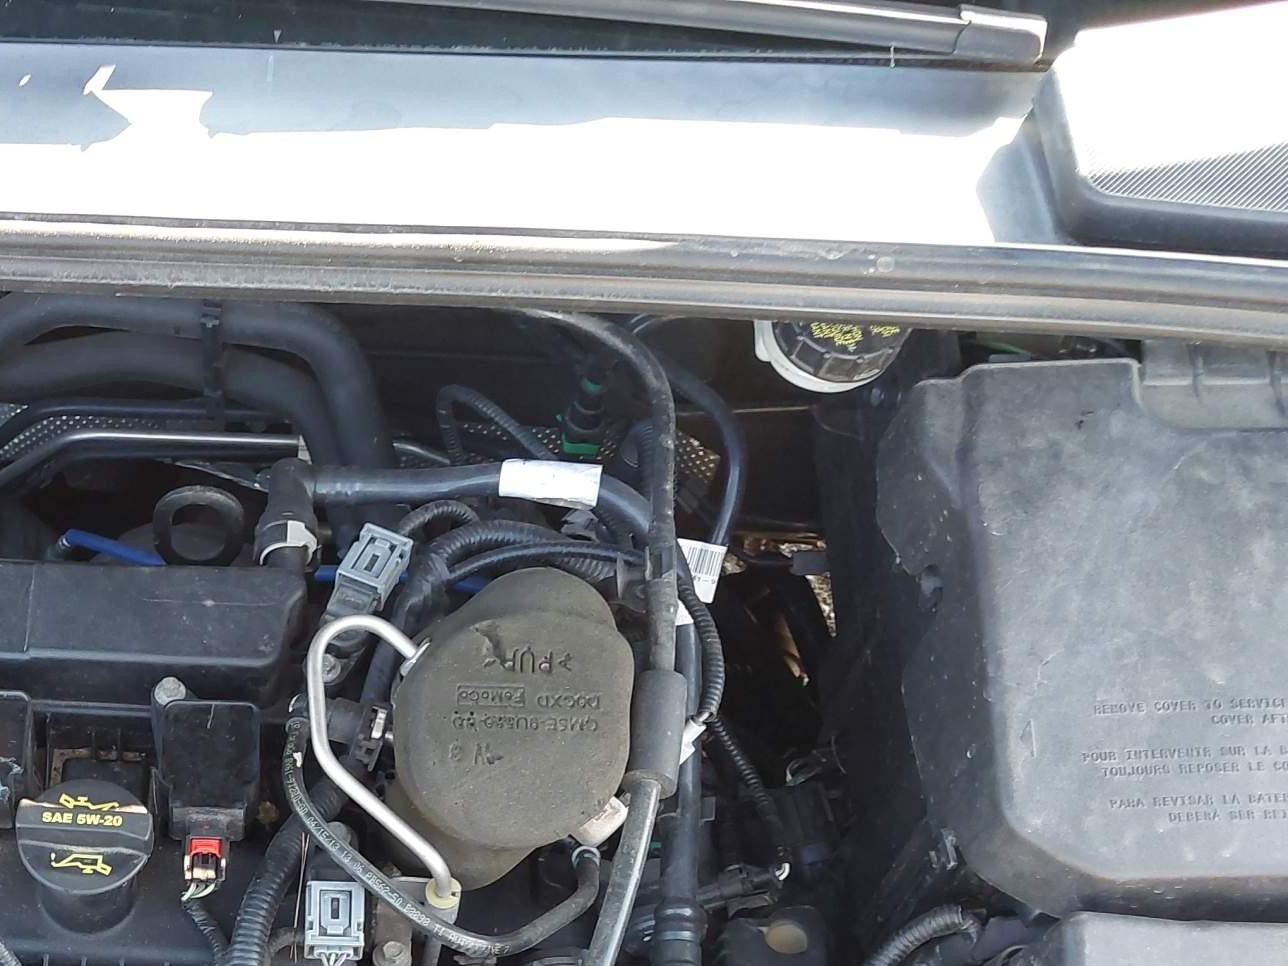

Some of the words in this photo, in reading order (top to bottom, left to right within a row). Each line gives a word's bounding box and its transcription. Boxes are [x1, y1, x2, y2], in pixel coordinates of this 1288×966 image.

[1093, 702, 1146, 715] REMOVE
[1154, 700, 1196, 712] COVER
[1205, 698, 1223, 709] TO
[1211, 713, 1254, 725] COVER
[1081, 751, 1117, 764] POUR
[1219, 745, 1246, 757] SUR
[1102, 763, 1170, 777] TOUJOURS
[1178, 761, 1240, 774] REPOSER
[1248, 761, 1265, 772] LE
[1110, 798, 1145, 809] PARA
[1152, 795, 1214, 807] REVISAR
[1223, 793, 1241, 805] LA
[42, 811, 73, 824] SAE
[76, 813, 123, 827] 5W-20
